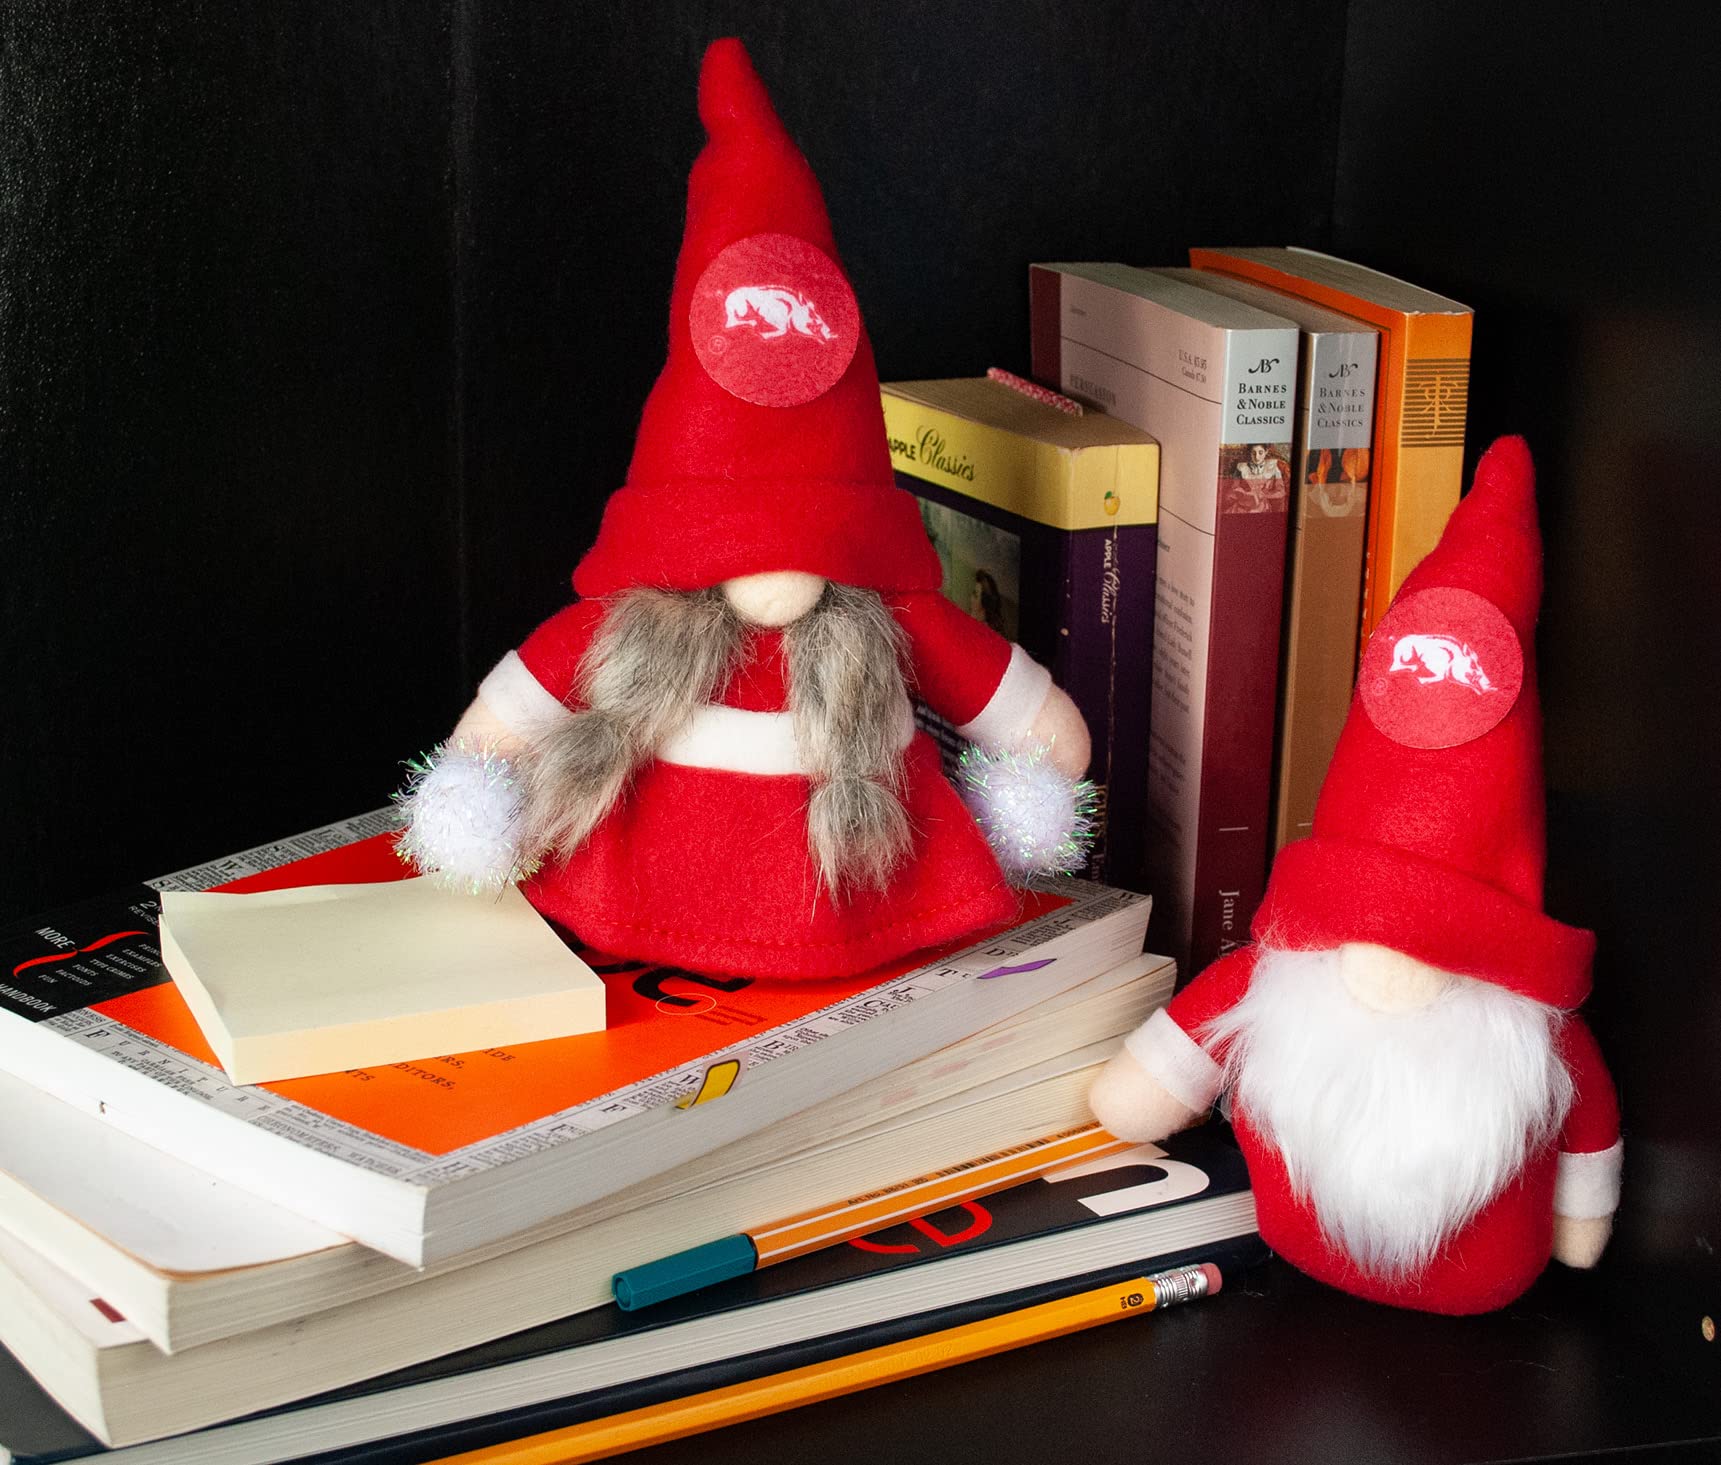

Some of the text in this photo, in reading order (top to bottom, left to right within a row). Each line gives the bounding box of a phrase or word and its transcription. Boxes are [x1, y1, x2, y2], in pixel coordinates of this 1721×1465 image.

[1238, 383, 1288, 394] BARNES
[1319, 387, 1366, 399] BARNES
[1236, 414, 1286, 425] CLASSICS
[1316, 417, 1364, 429] CLASSICS
[916, 425, 976, 482] Classics
[1103, 538, 1113, 569] APPLE
[1218, 889, 1241, 931] Jane
[35, 926, 76, 949] MORE
[72, 963, 100, 977] FONTS
[105, 953, 148, 973] EXERCISES
[387, 1062, 455, 1091] DITORS,
[1128, 1293, 1143, 1306] 2
